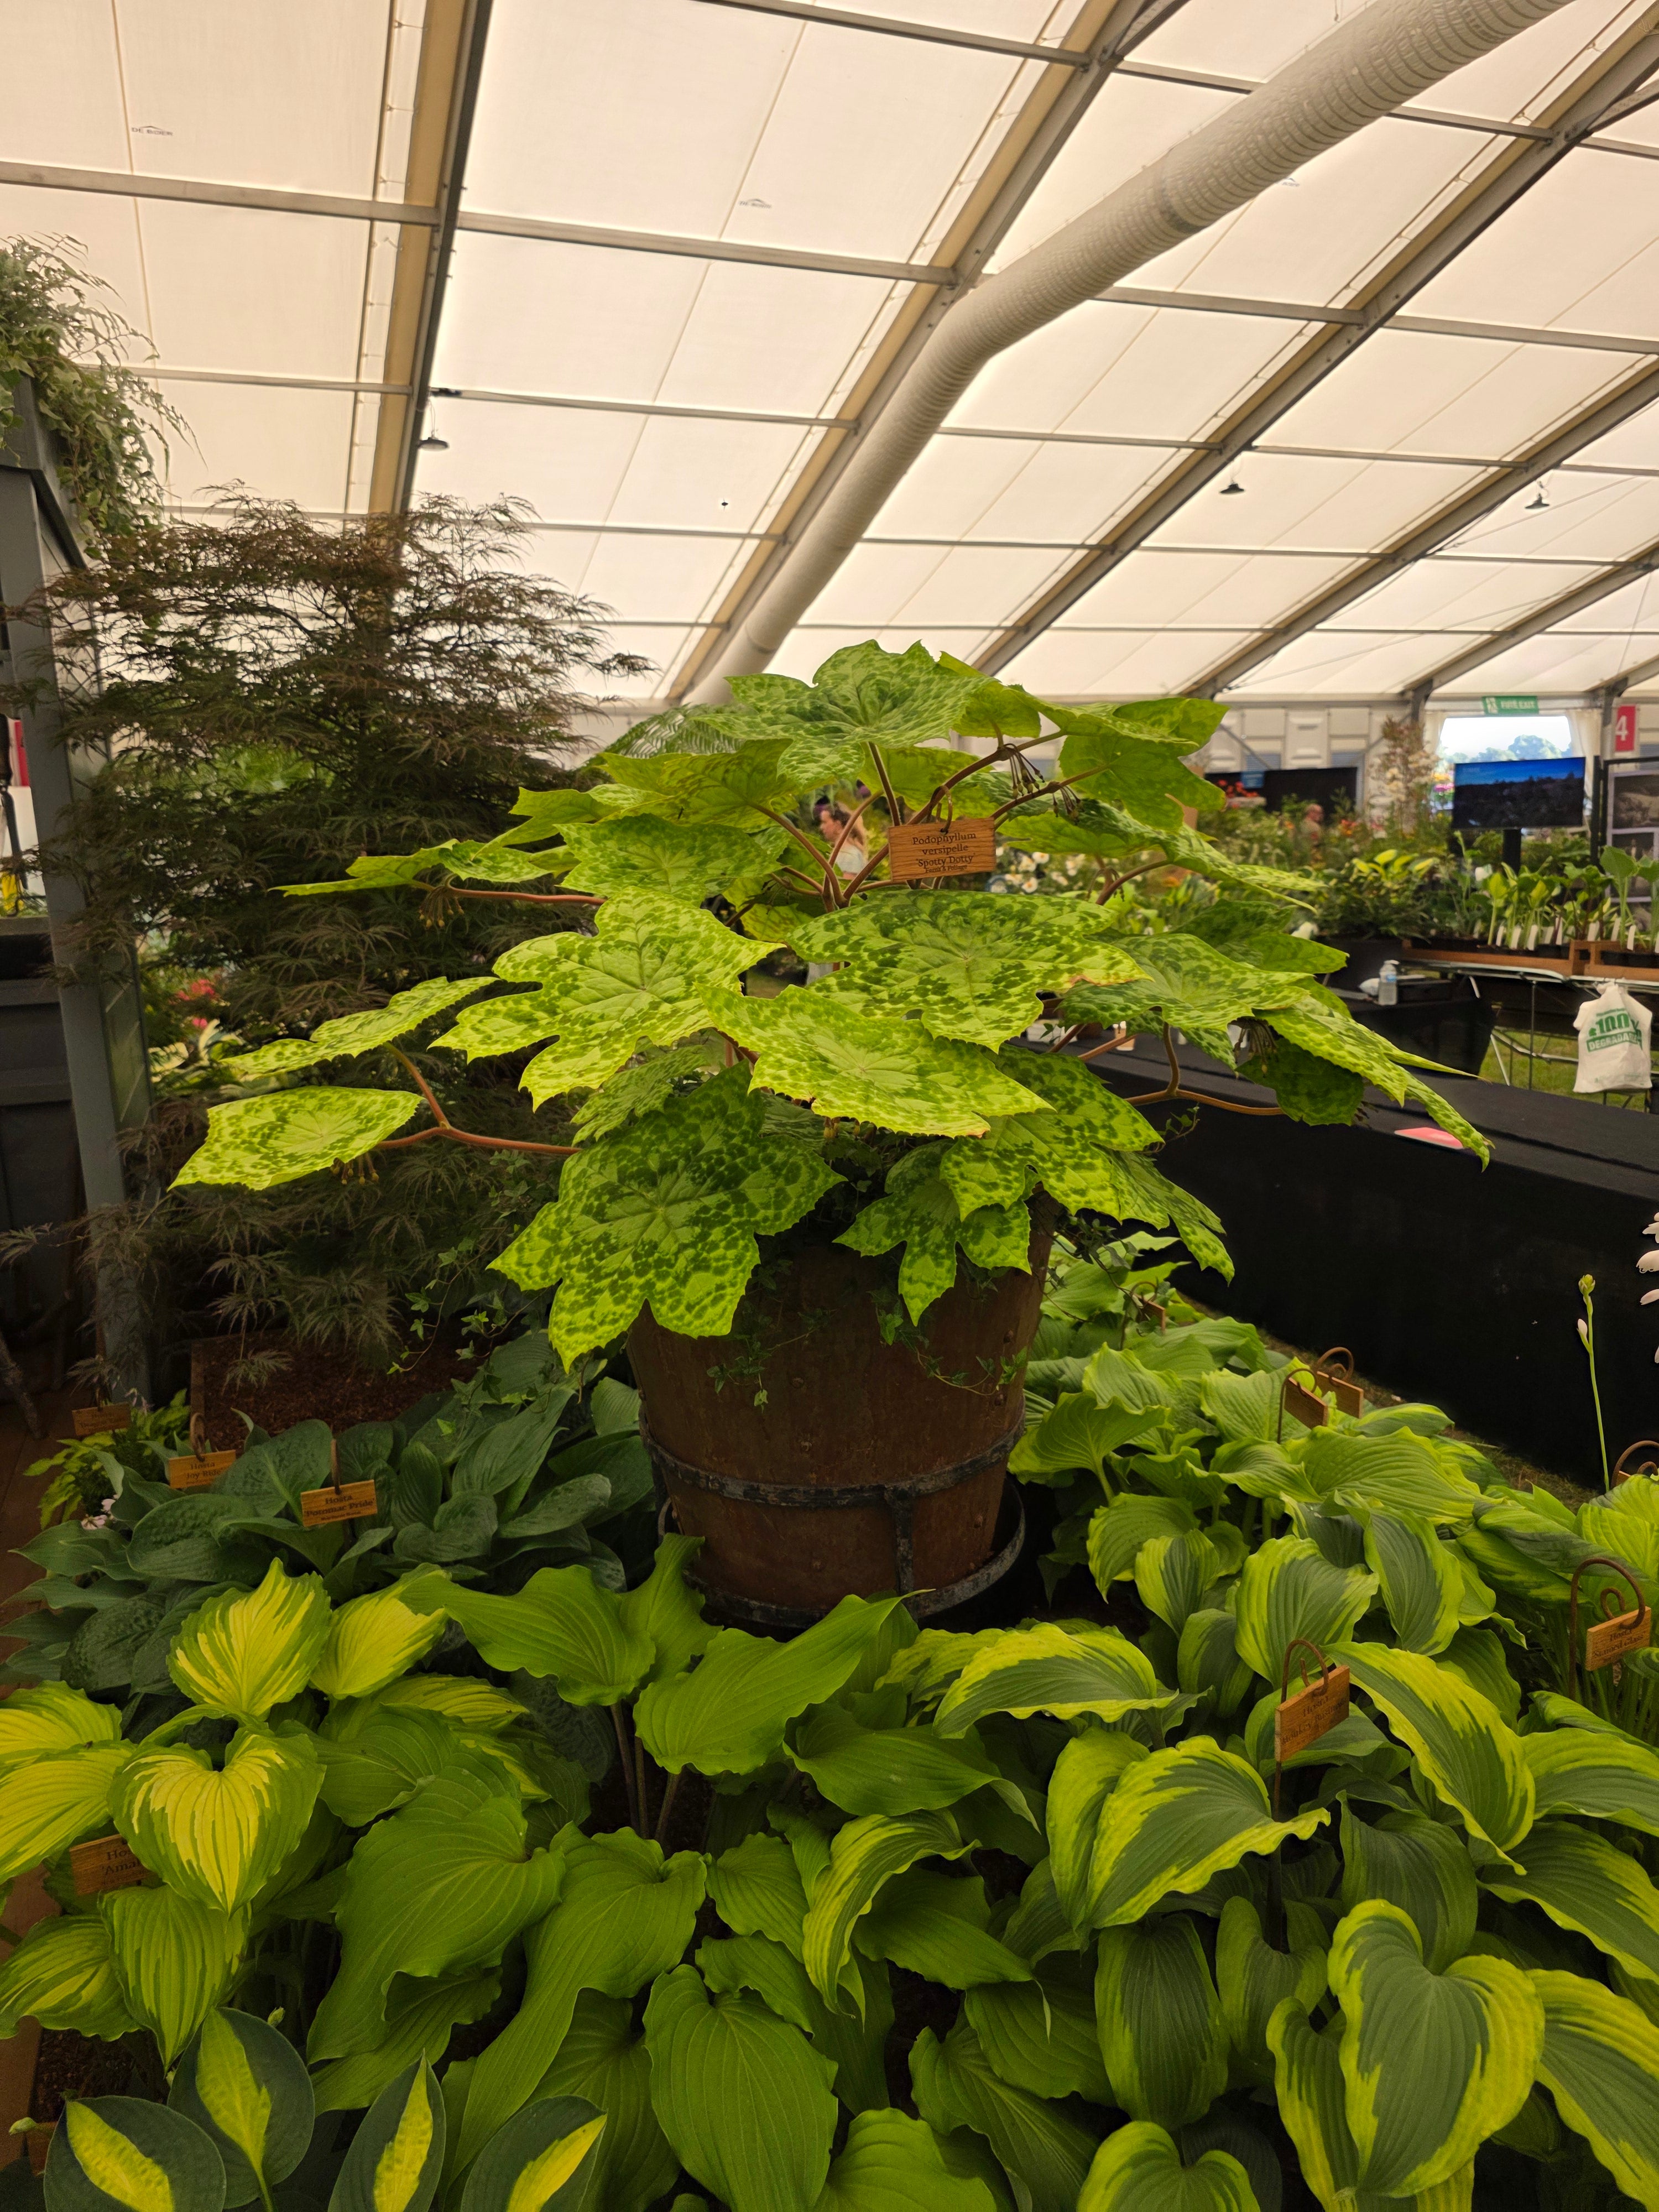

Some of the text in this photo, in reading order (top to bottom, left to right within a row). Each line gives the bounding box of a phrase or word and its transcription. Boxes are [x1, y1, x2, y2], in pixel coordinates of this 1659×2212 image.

[1500, 700, 1536, 709] FIRE EXIT
[1615, 715, 1629, 742] 4
[912, 832, 976, 845] Podophyllum
[922, 844, 968, 855] versipelle
[190, 1462, 216, 1470] Hosta
[325, 1495, 353, 1505] Hosta
[1609, 1630, 1632, 1642] Hosta
[1303, 1695, 1328, 1717] Hosta
[107, 1849, 131, 1860] Ho
